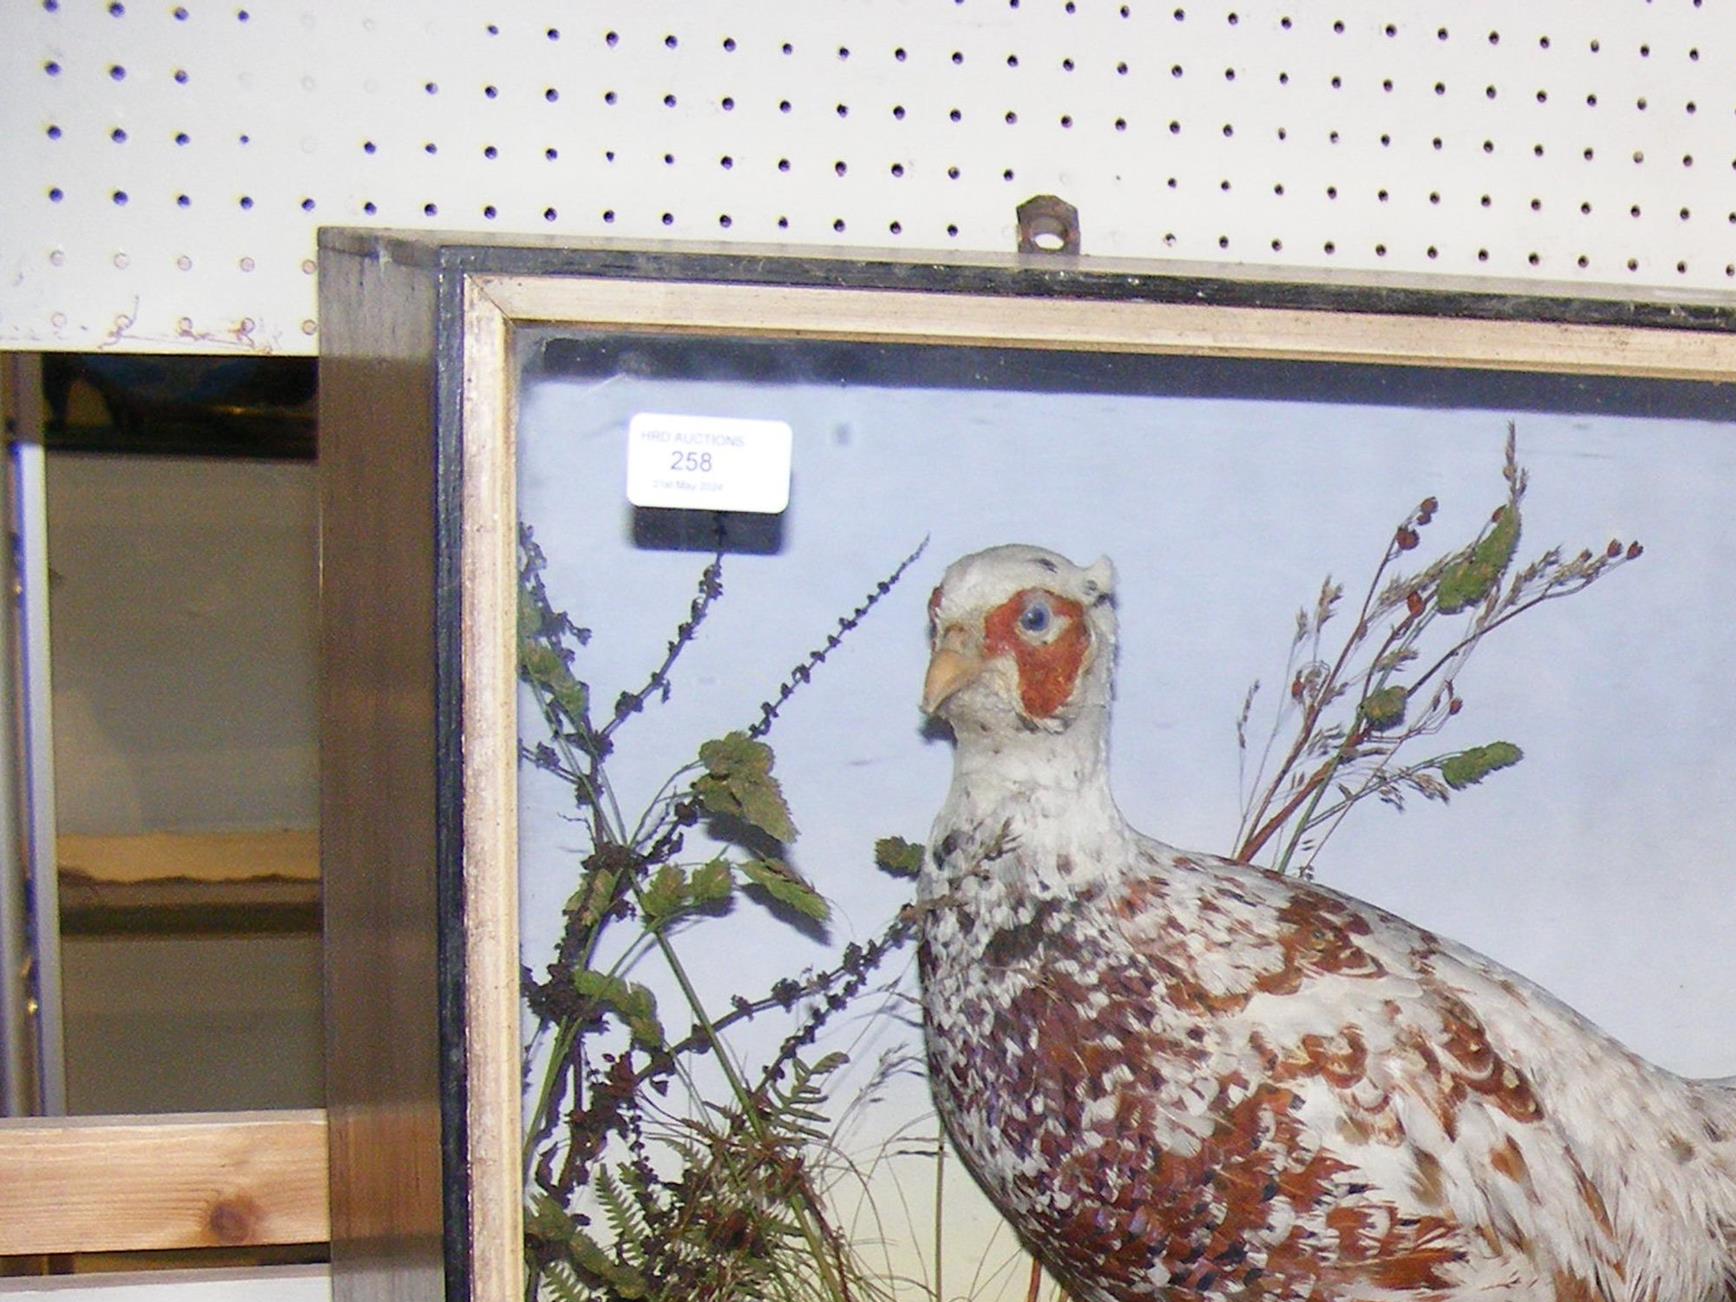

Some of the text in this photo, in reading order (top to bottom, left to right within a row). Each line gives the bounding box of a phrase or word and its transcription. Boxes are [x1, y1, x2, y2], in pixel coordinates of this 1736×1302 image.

[640, 430, 746, 448] HRD AUCTIONS
[669, 449, 713, 473] 258
[675, 479, 697, 493] May
